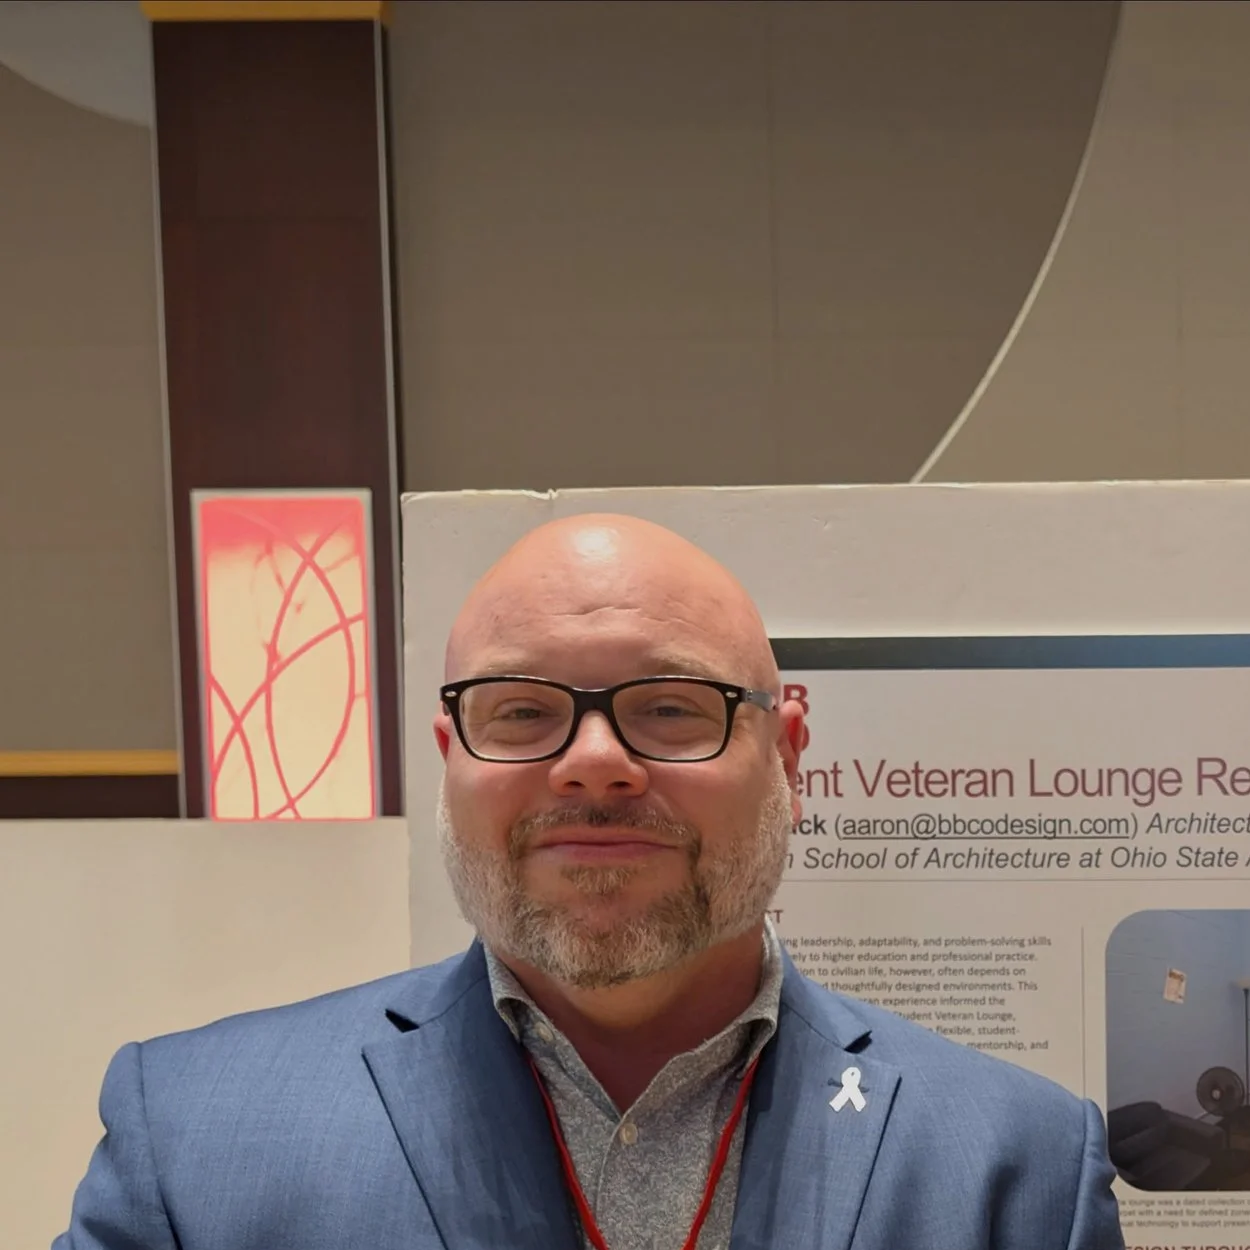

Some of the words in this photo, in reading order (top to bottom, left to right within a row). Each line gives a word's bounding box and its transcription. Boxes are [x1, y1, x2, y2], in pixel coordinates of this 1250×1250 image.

[852, 757, 1014, 798] Veteran
[1028, 757, 1183, 806] Lounge
[833, 811, 1138, 842] (aaron@bbcodesign.com)
[802, 846, 888, 869] School
[894, 846, 921, 869] of
[922, 846, 1071, 869] Architecture
[1078, 847, 1103, 868] at
[1110, 845, 1167, 868] Ohio
[1175, 845, 1239, 868] State
[800, 936, 855, 948] leadership,
[858, 936, 919, 948] adaptability,
[922, 936, 941, 946] and
[944, 936, 1025, 948] problem-solving
[1027, 936, 1052, 946] skills
